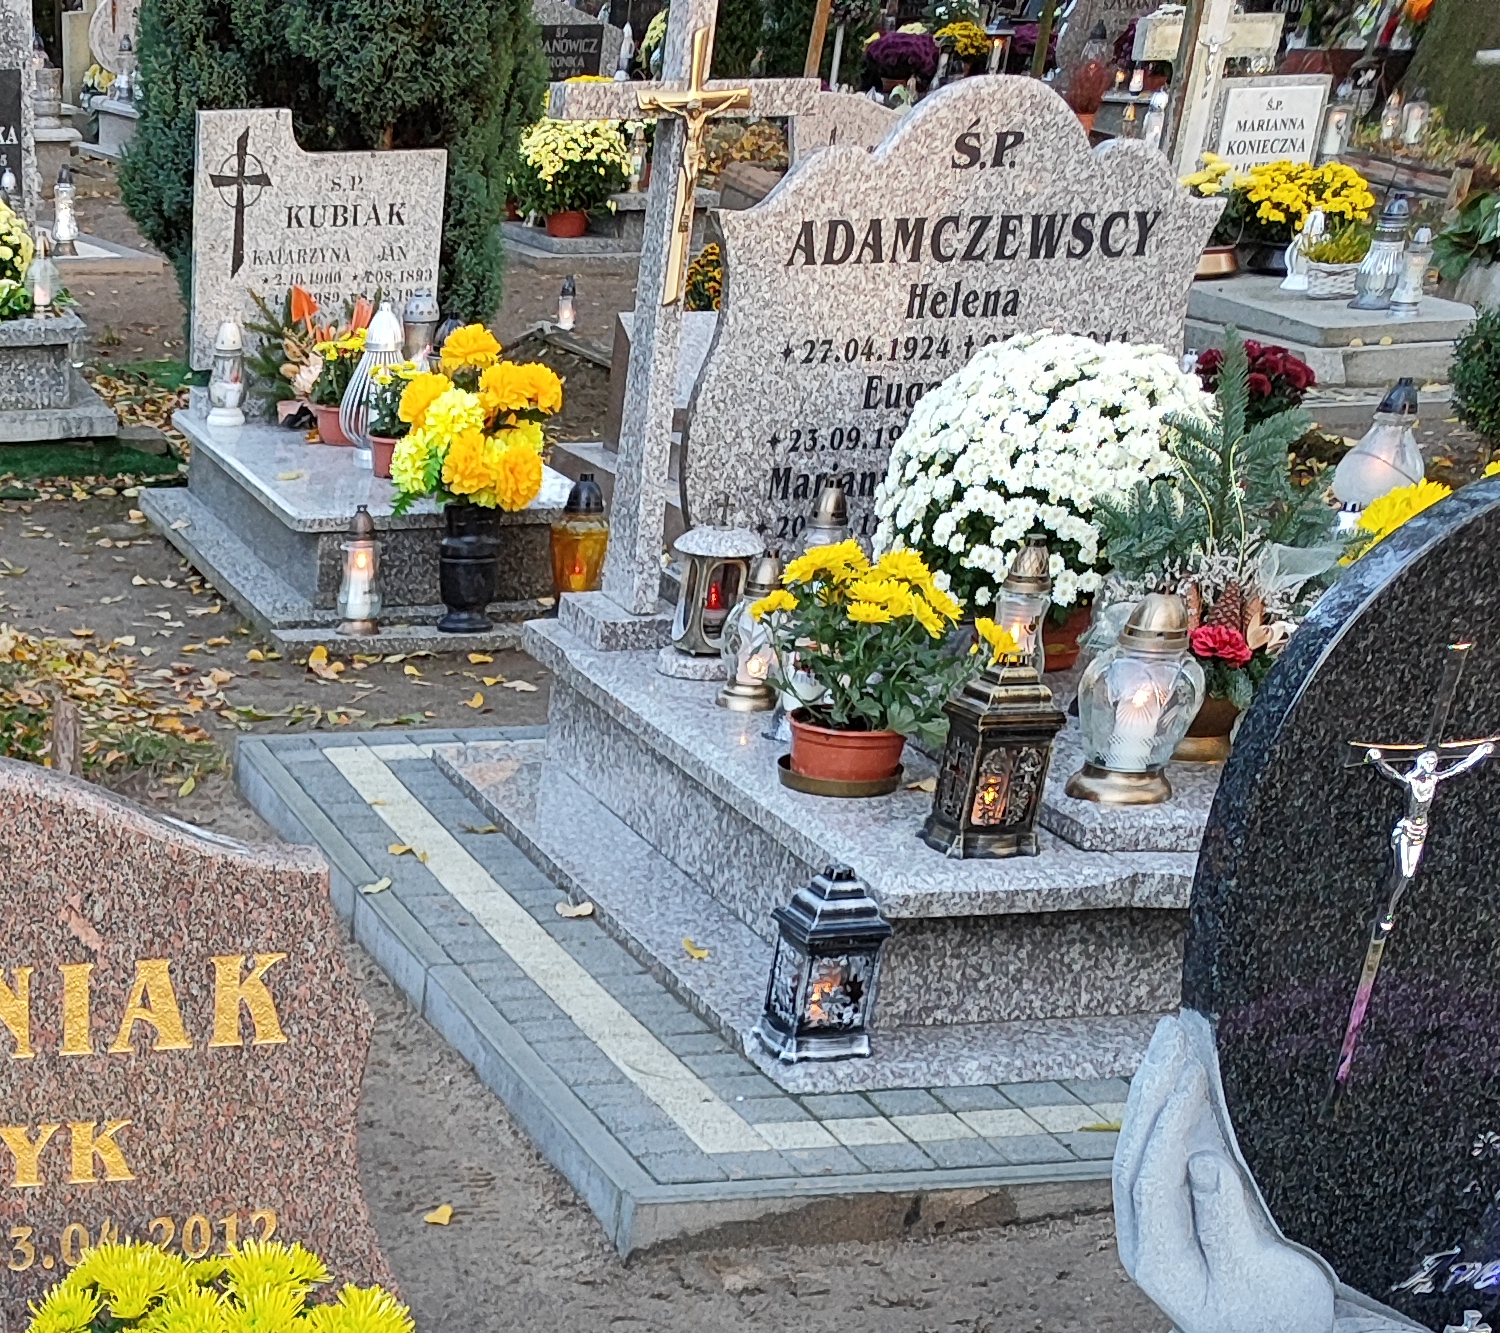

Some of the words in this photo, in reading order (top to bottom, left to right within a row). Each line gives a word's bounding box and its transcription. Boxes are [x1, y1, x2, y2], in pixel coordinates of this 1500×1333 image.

[543, 38, 598, 53] ANOWICZ
[1235, 118, 1305, 133] MARIANNA
[1226, 138, 1306, 156] KONIECZNA
[284, 202, 406, 229] KUBIAK
[786, 210, 1162, 268] ADAMCZEWSCY
[253, 247, 351, 266] KATARZYNA
[377, 245, 408, 262] JAN
[905, 282, 1020, 320] Helena
[801, 333, 951, 364] 27.04.1924
